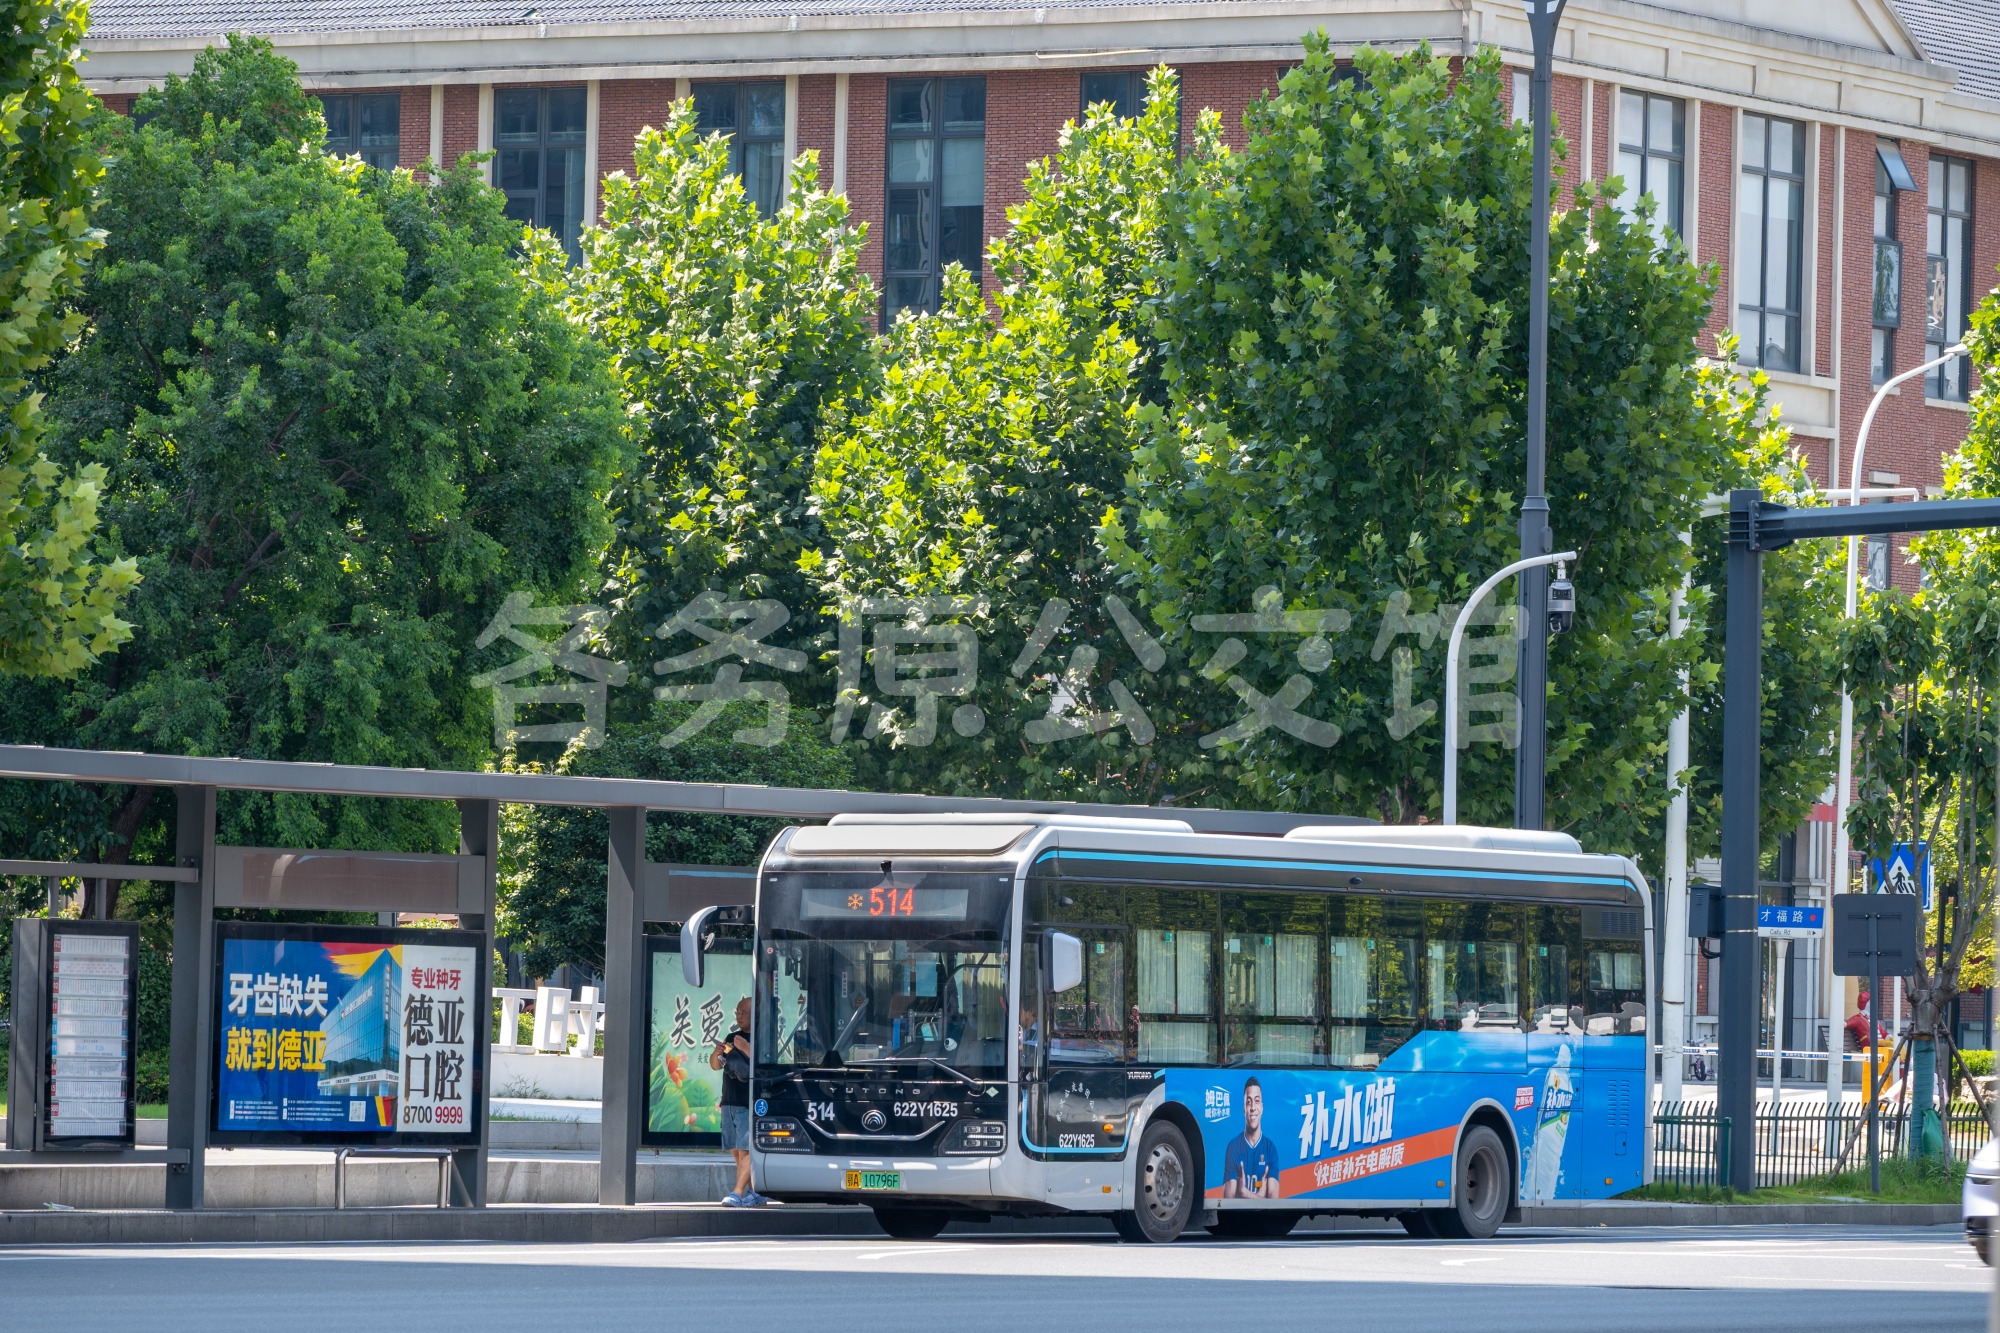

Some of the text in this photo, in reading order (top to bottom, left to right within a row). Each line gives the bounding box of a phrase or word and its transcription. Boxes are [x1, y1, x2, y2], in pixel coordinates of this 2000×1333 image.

[869, 887, 914, 917] 514
[1760, 908, 1804, 924] 才福路
[411, 966, 462, 991] 专业种牙
[228, 972, 329, 1018] 牙齿缺失
[404, 992, 465, 1049] 德亚
[225, 1026, 327, 1072] 就到德亚
[404, 1049, 465, 1103] 口腔
[1126, 1071, 1153, 1080] YUTONG
[829, 1087, 921, 1095] YUTONG
[1204, 1088, 1231, 1107] 姆巴佩
[403, 1105, 463, 1124] 8700 9999
[807, 1101, 836, 1121] 514
[893, 1101, 959, 1117] 622Y1625
[1298, 1076, 1396, 1160] 补水啦
[1058, 1133, 1096, 1149] 622Y1625
[1314, 1142, 1405, 1187] 快速补充电解质
